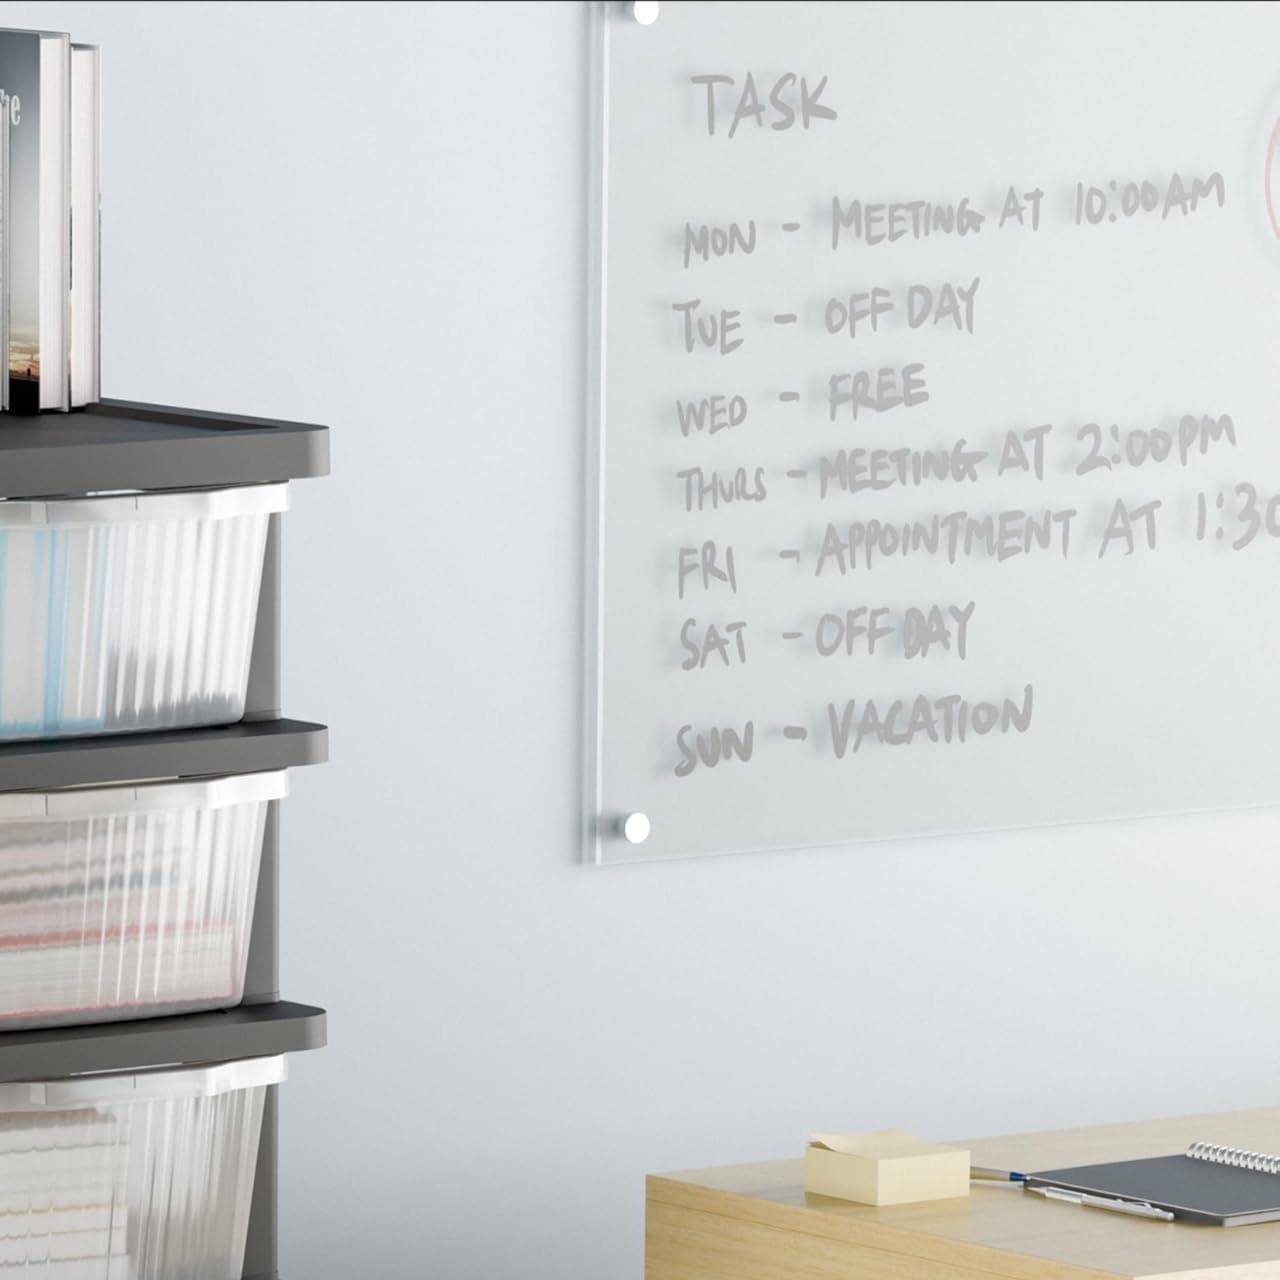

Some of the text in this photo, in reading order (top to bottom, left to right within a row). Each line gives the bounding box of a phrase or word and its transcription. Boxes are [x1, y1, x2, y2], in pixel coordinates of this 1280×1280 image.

[690, 72, 837, 139] TASK
[682, 220, 756, 268] MON
[830, 196, 985, 250] MEETING
[999, 187, 1043, 231] AT
[672, 299, 744, 355] TUE
[824, 287, 894, 338] OFF
[906, 277, 980, 334] DAY
[676, 394, 747, 437] WED
[828, 363, 929, 421] FREE
[675, 467, 766, 513] THURS
[819, 438, 989, 499] MEETING
[998, 424, 1052, 481] AT
[678, 539, 737, 600] FRI
[816, 508, 1077, 577] APPOINTMENT
[1098, 498, 1162, 559] AT
[680, 618, 748, 671] SAT
[815, 605, 896, 656] OFF
[903, 600, 976, 661] DAY
[674, 720, 754, 778] SUN
[827, 683, 1033, 760] VACATION
